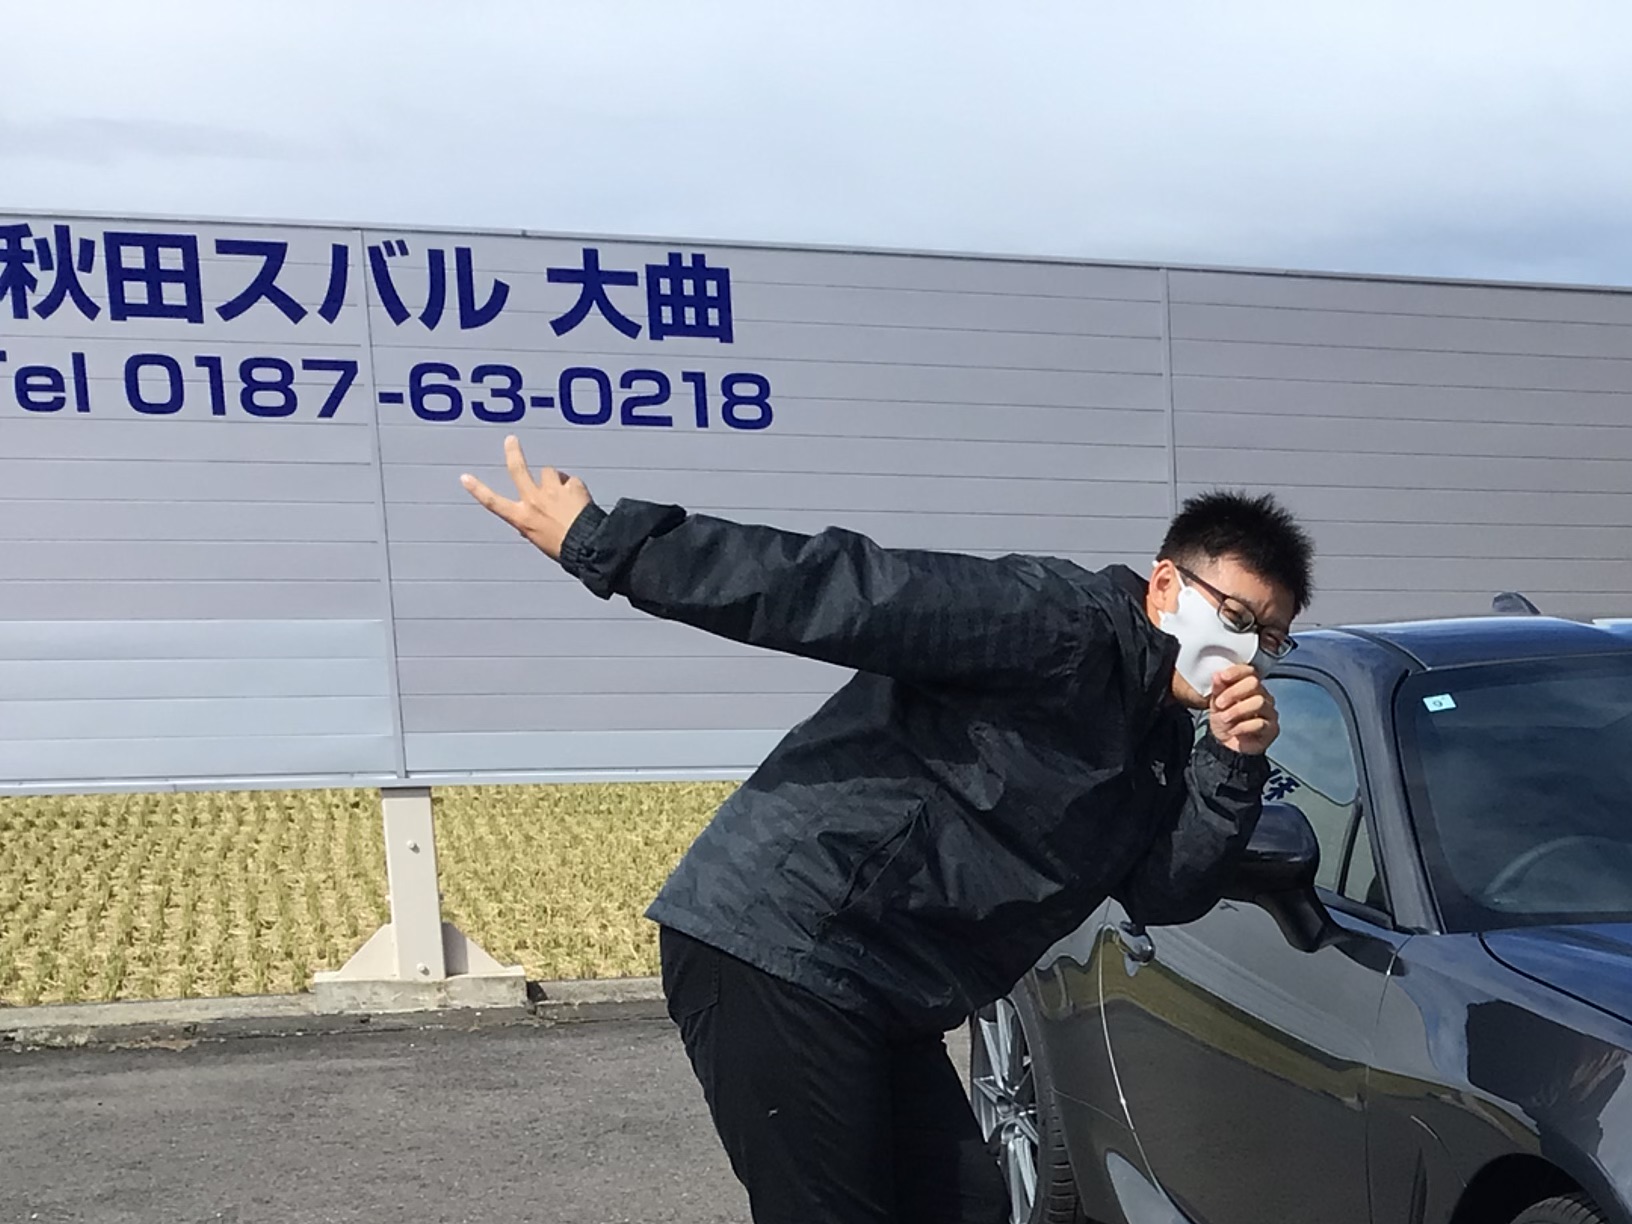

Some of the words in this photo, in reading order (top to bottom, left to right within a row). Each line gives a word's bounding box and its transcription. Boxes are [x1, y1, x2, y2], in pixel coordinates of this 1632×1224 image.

[0, 223, 511, 331] 秋田スバル
[546, 247, 734, 344] 大曲
[0, 350, 91, 413] el
[124, 353, 775, 431] 0187-63-0218
